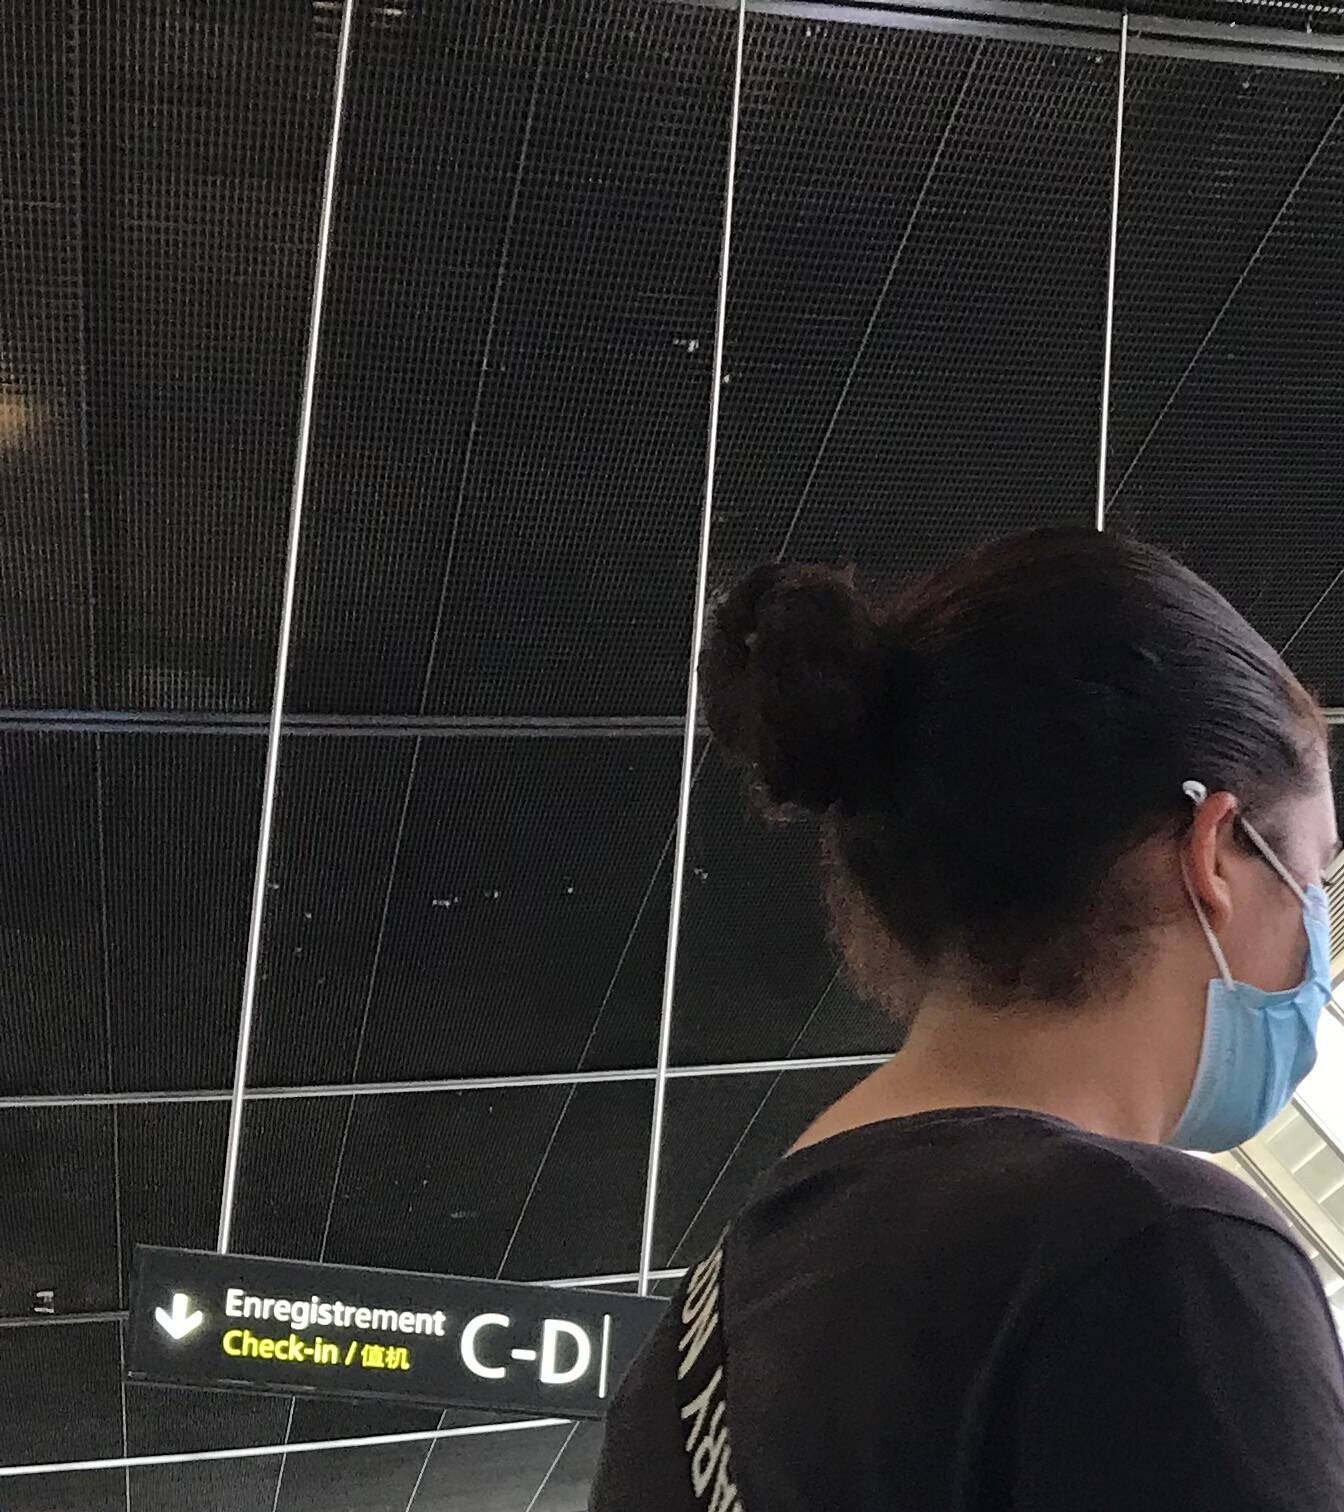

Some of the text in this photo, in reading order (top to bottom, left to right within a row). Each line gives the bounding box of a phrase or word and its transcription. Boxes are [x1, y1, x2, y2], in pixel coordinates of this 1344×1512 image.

[226, 1289, 446, 1336] Enregistrement
[222, 1328, 410, 1371] Check-in / 值机
[459, 1312, 592, 1385] C-D
